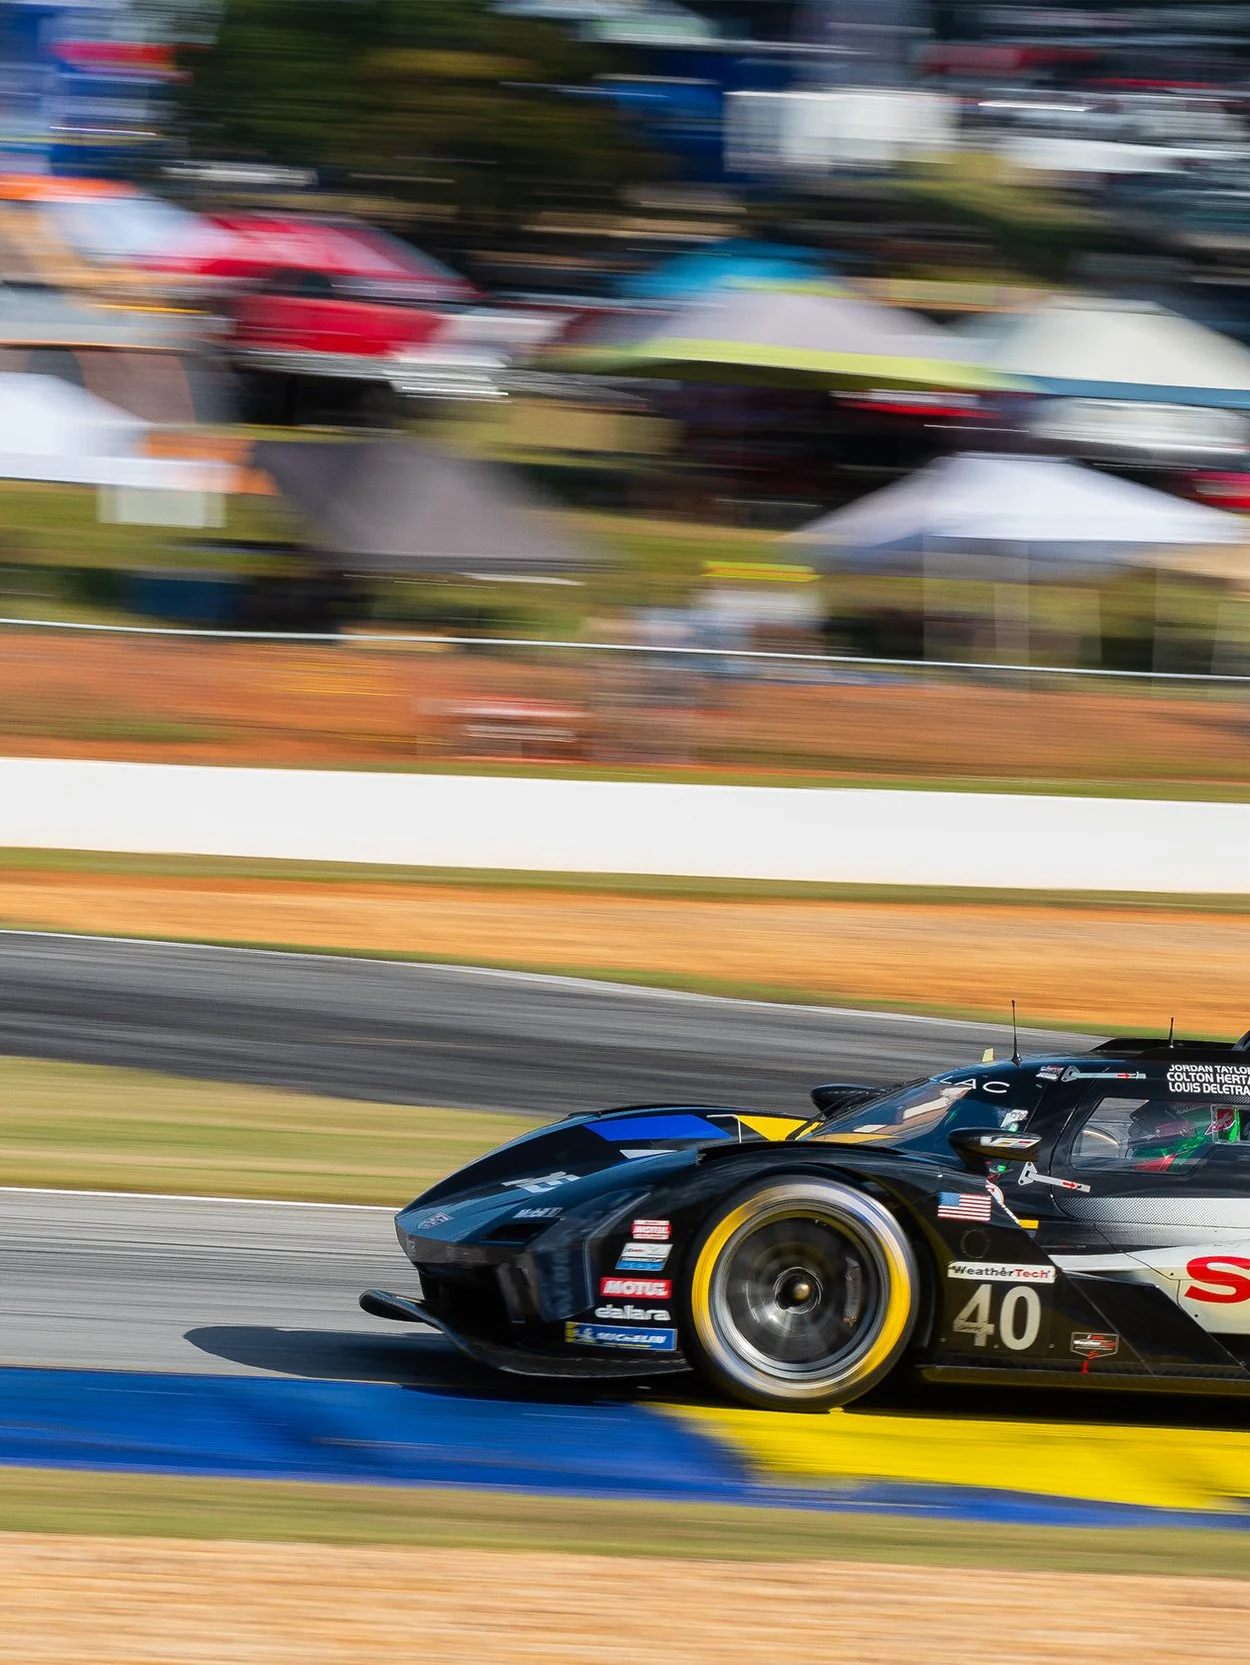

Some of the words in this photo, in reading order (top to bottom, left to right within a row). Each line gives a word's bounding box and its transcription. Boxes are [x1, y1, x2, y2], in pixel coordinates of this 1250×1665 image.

[1168, 1064, 1213, 1072] JORDAN
[1166, 1072, 1214, 1083] COLTON
[1168, 1082, 1201, 1093] LOUIS
[951, 1265, 1049, 1279] WeatherTech
[603, 1280, 668, 1296] MOTUL
[595, 1304, 672, 1321] dallara
[953, 1283, 1041, 1350] 40
